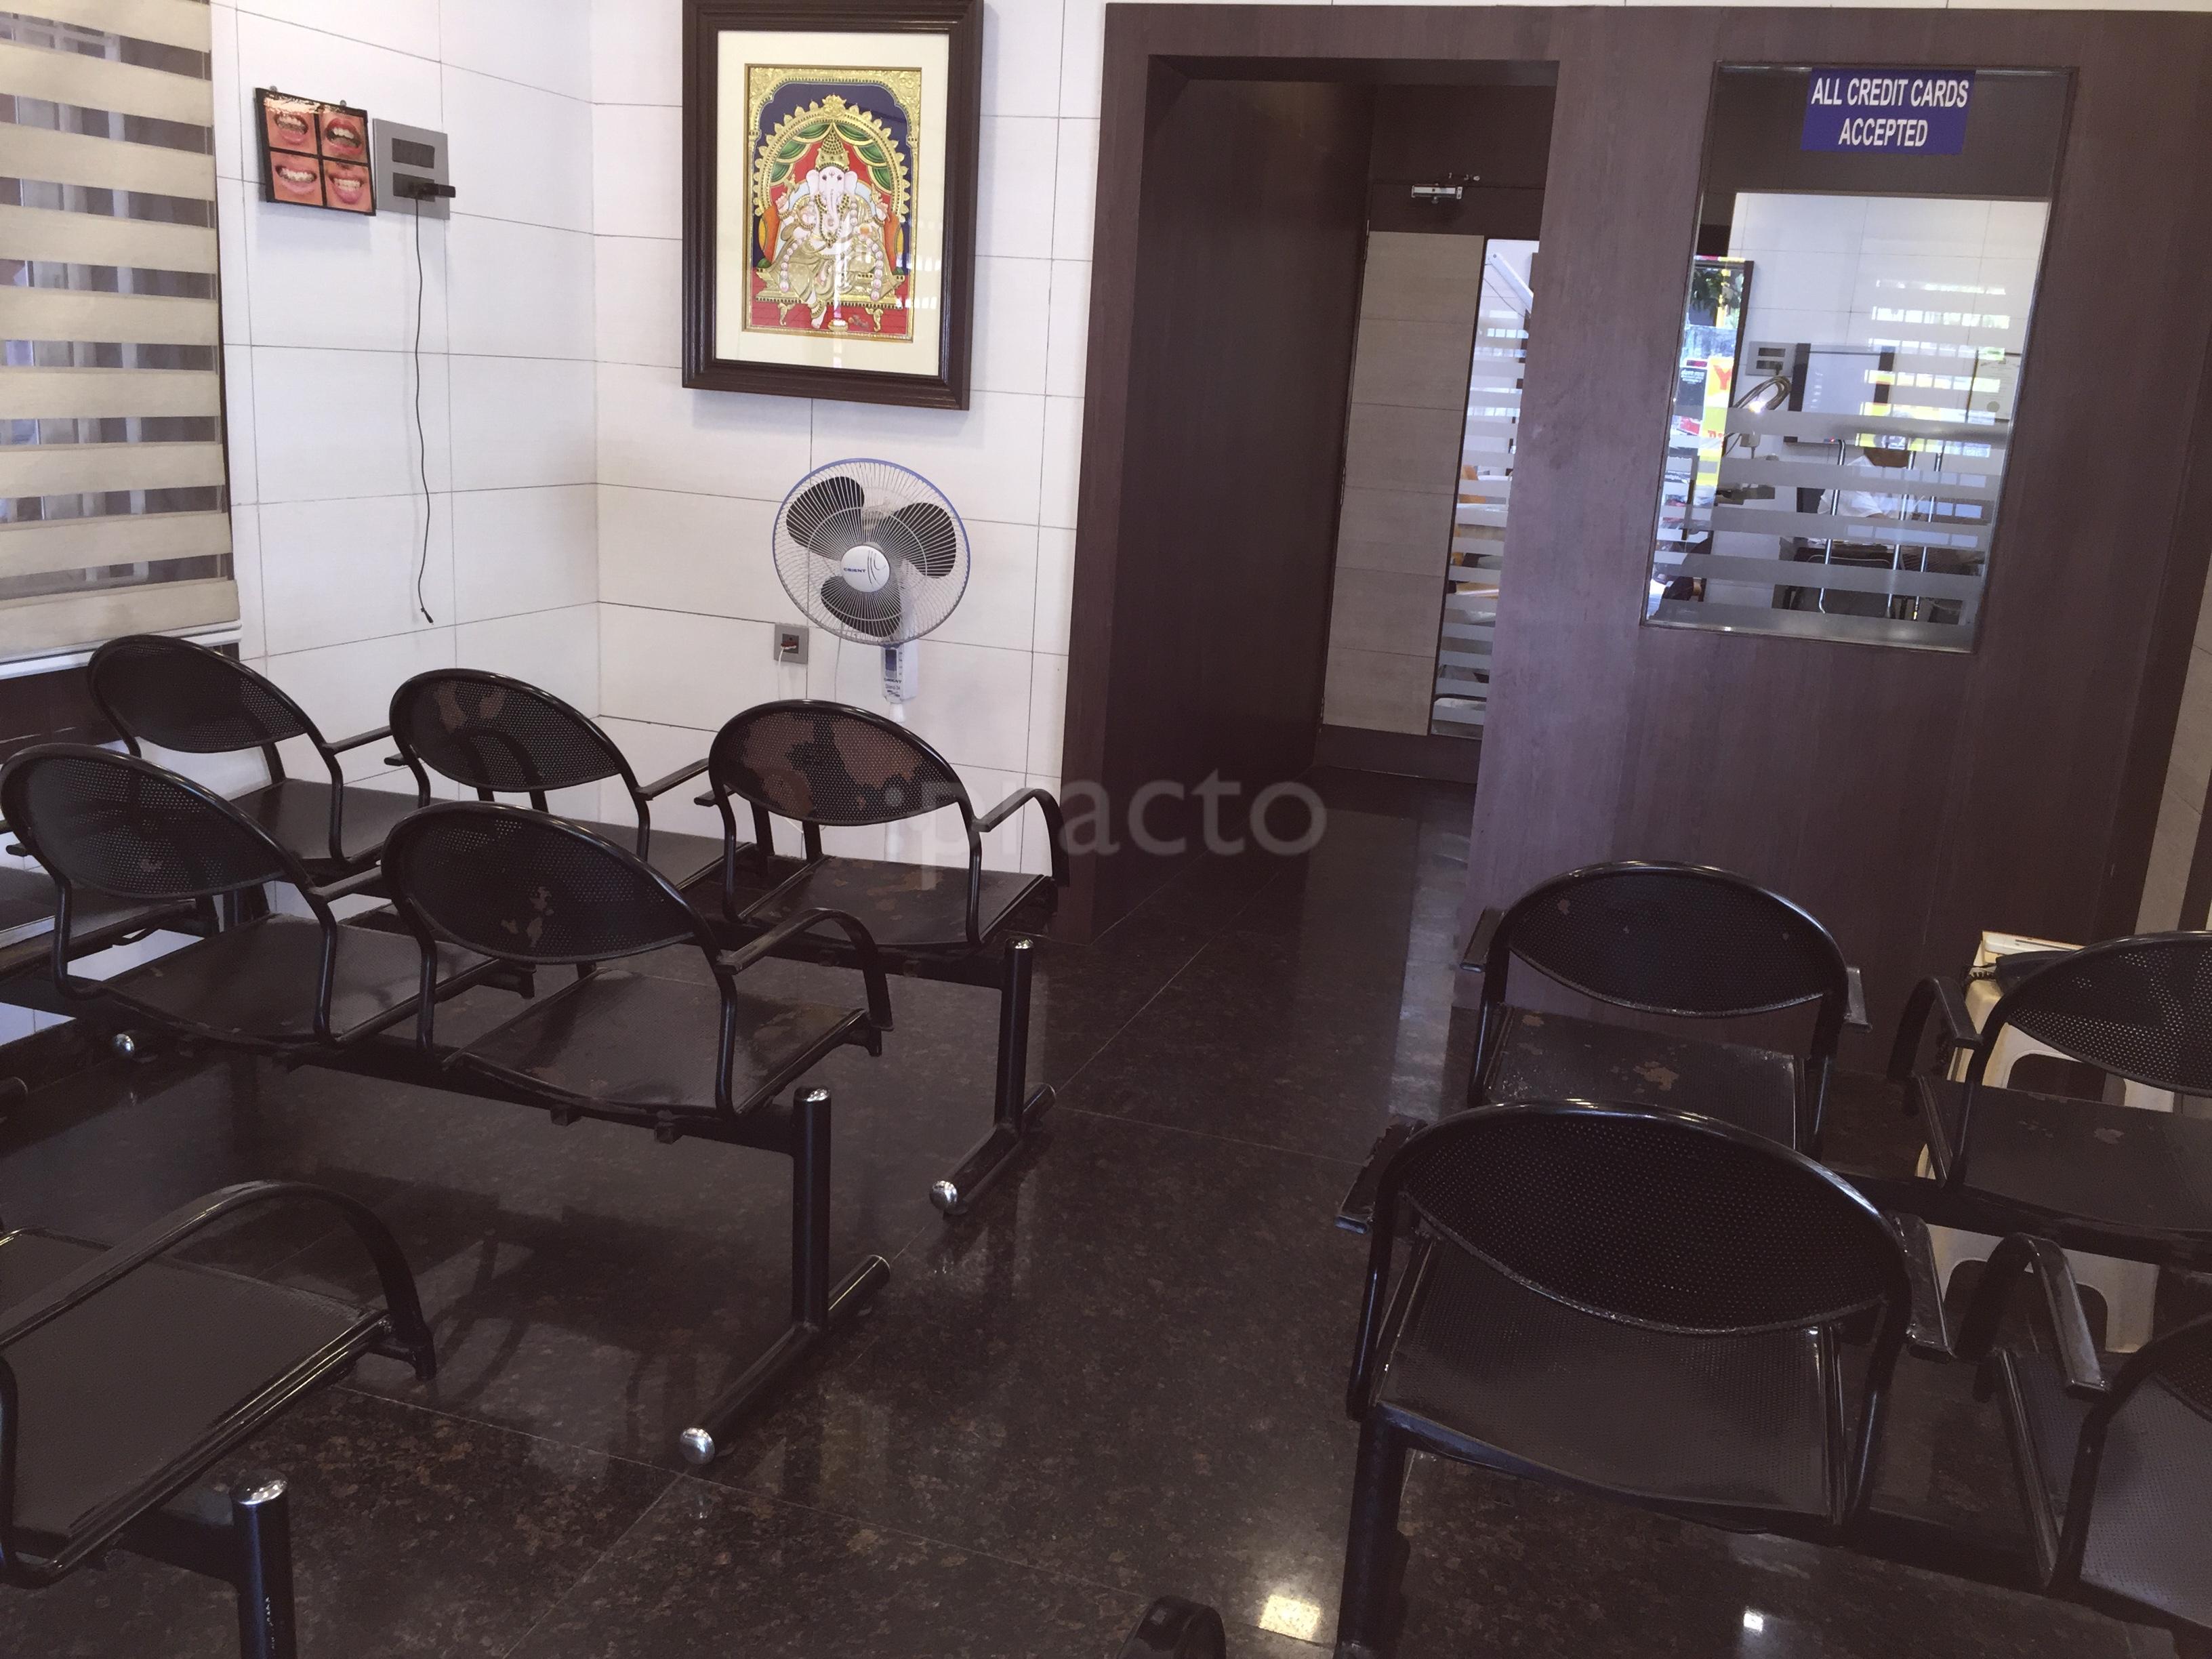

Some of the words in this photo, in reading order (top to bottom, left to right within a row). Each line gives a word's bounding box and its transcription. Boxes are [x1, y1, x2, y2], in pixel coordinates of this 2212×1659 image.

[1811, 78, 1843, 105] ALL
[1847, 78, 1908, 106] CREDIT
[1910, 79, 1969, 108] CARDS
[1838, 118, 1928, 147] ACCEPTED
